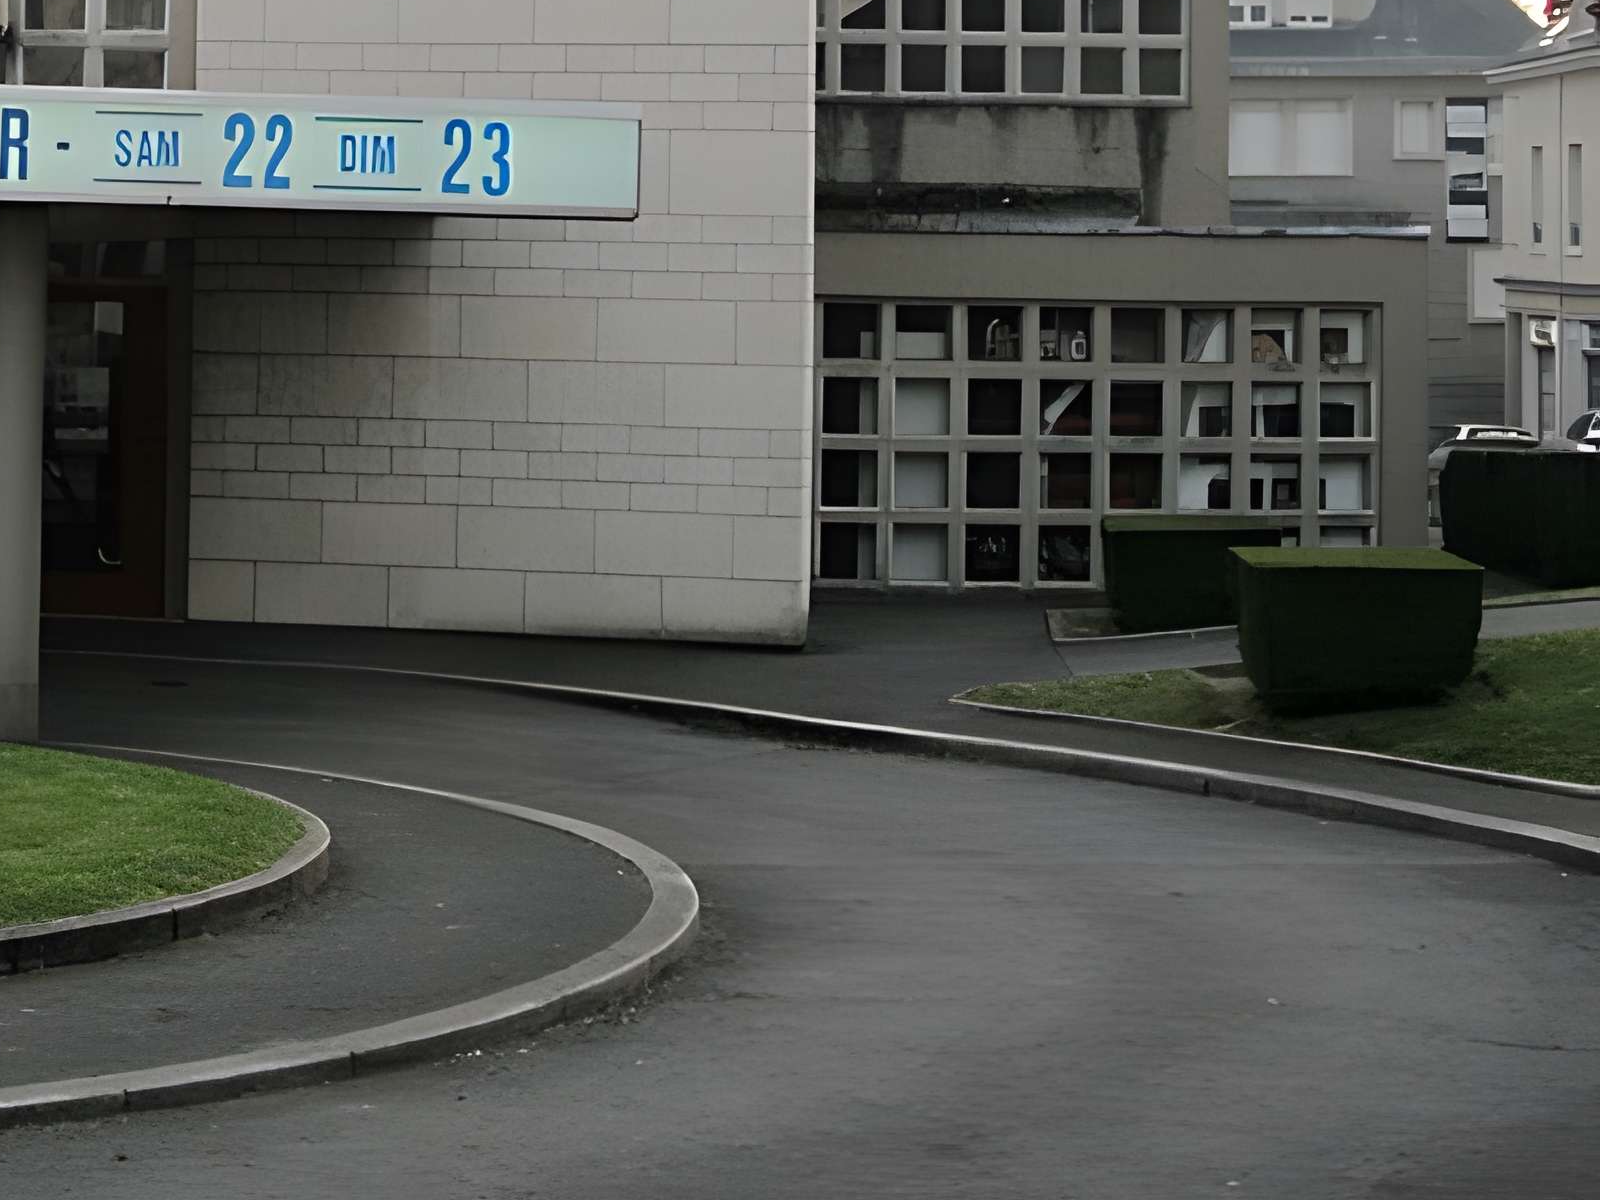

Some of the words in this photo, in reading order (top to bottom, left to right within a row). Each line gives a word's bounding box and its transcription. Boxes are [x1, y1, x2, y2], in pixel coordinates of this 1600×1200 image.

[114, 129, 180, 169] SAM
[222, 111, 294, 190] 22
[339, 133, 397, 177] DIM
[440, 117, 511, 198] 23
